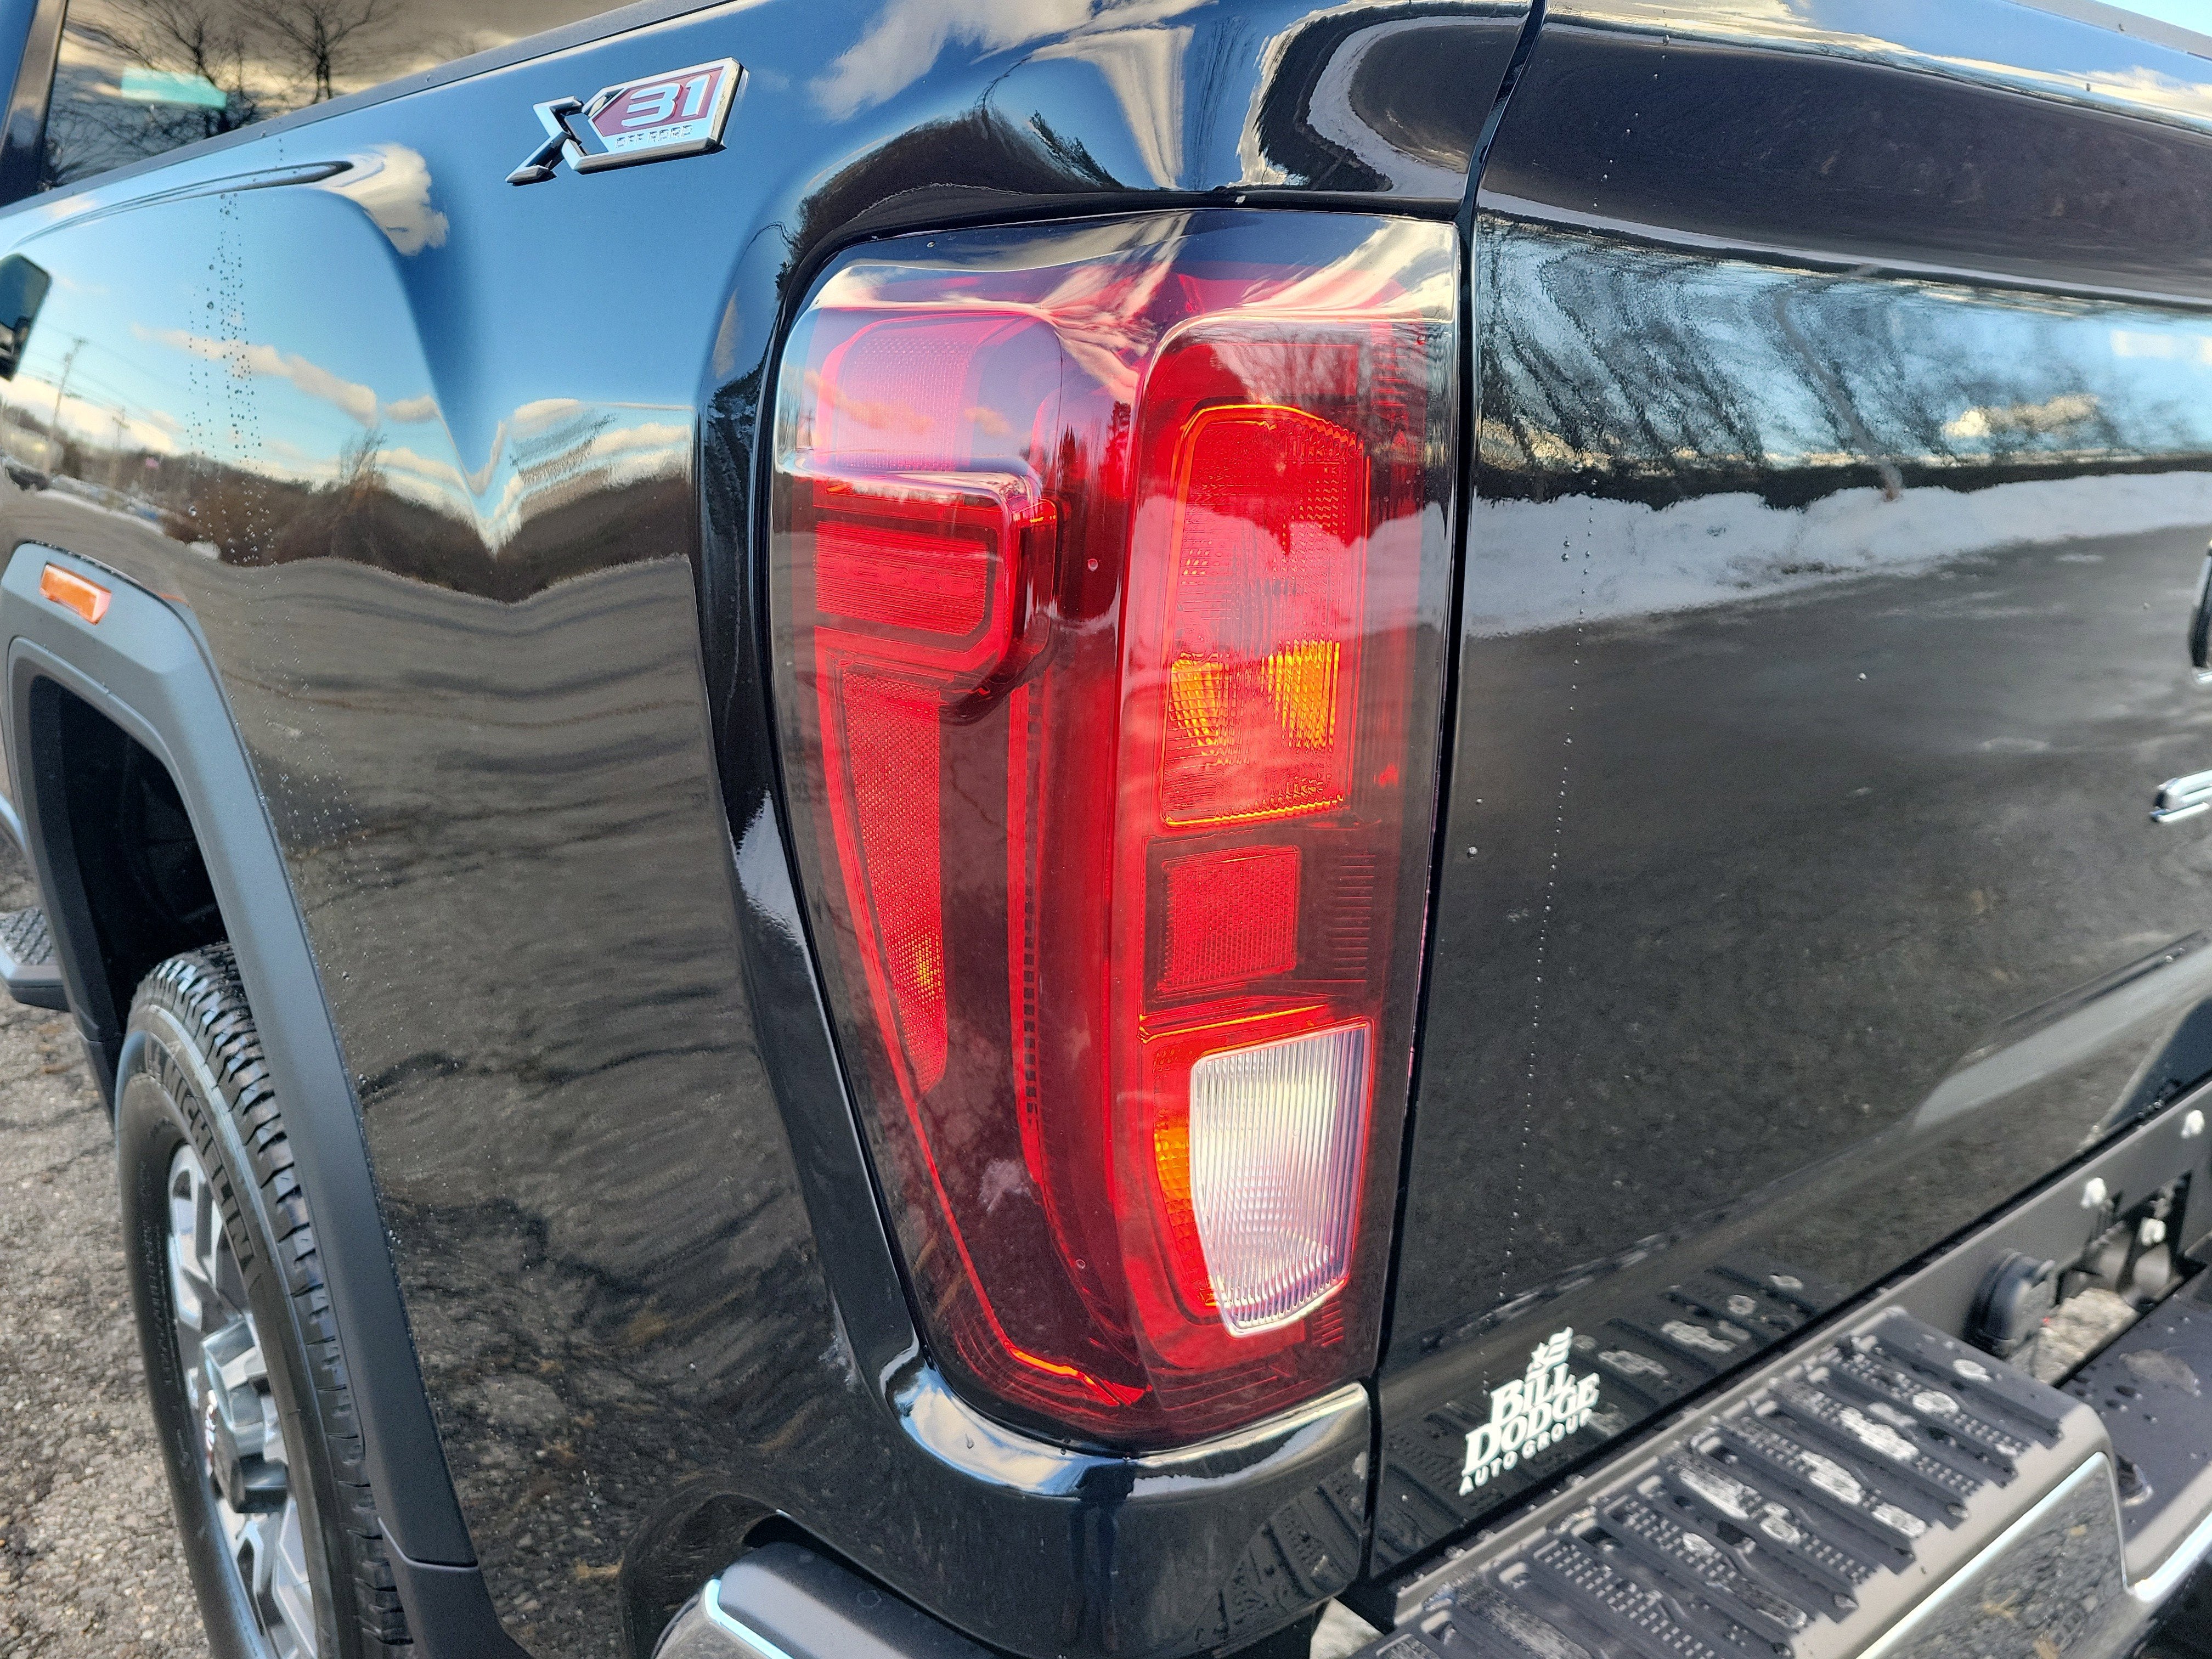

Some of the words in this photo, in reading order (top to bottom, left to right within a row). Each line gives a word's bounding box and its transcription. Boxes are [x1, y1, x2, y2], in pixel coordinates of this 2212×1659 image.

[615, 133, 645, 149] OFF
[647, 125, 693, 143] ROAD
[815, 554, 976, 595] SIERRA
[1462, 1373, 1600, 1477] DODGE
[1490, 1363, 1578, 1427] BILL
[1459, 1450, 1518, 1496] AUTO
[1522, 1408, 1593, 1459] GROUP
